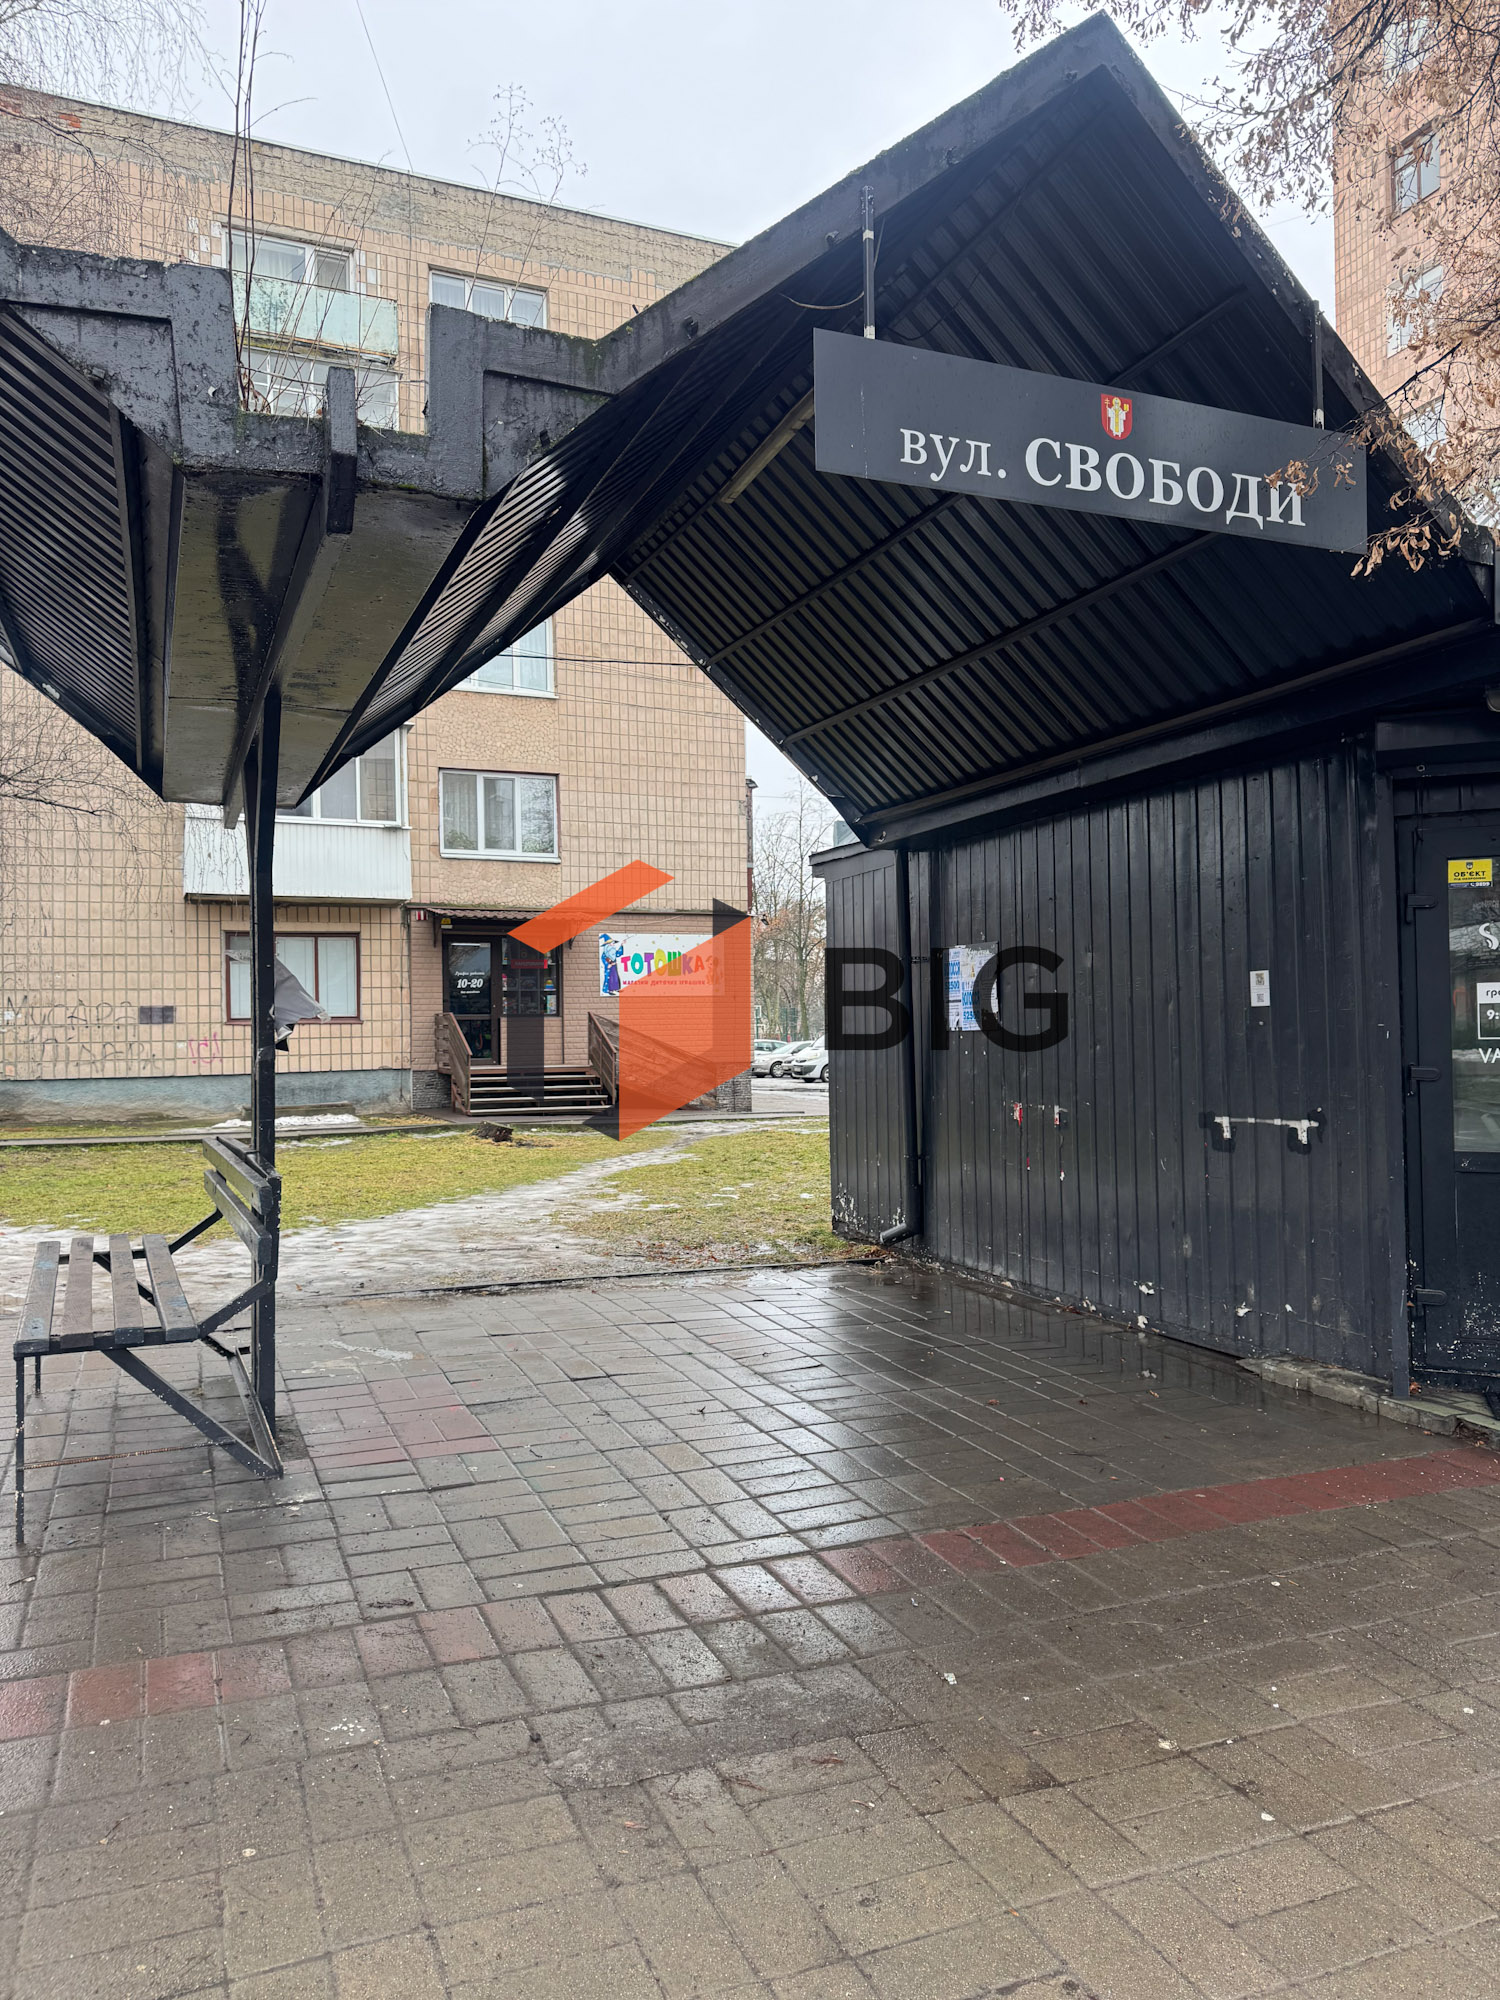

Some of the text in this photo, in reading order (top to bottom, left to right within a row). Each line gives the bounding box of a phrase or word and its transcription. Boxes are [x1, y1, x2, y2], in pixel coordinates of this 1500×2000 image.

[900, 428, 1306, 530] вул. СВОБОДИ
[620, 948, 705, 976] ТОТОШКА
[457, 978, 483, 988] 10-20
